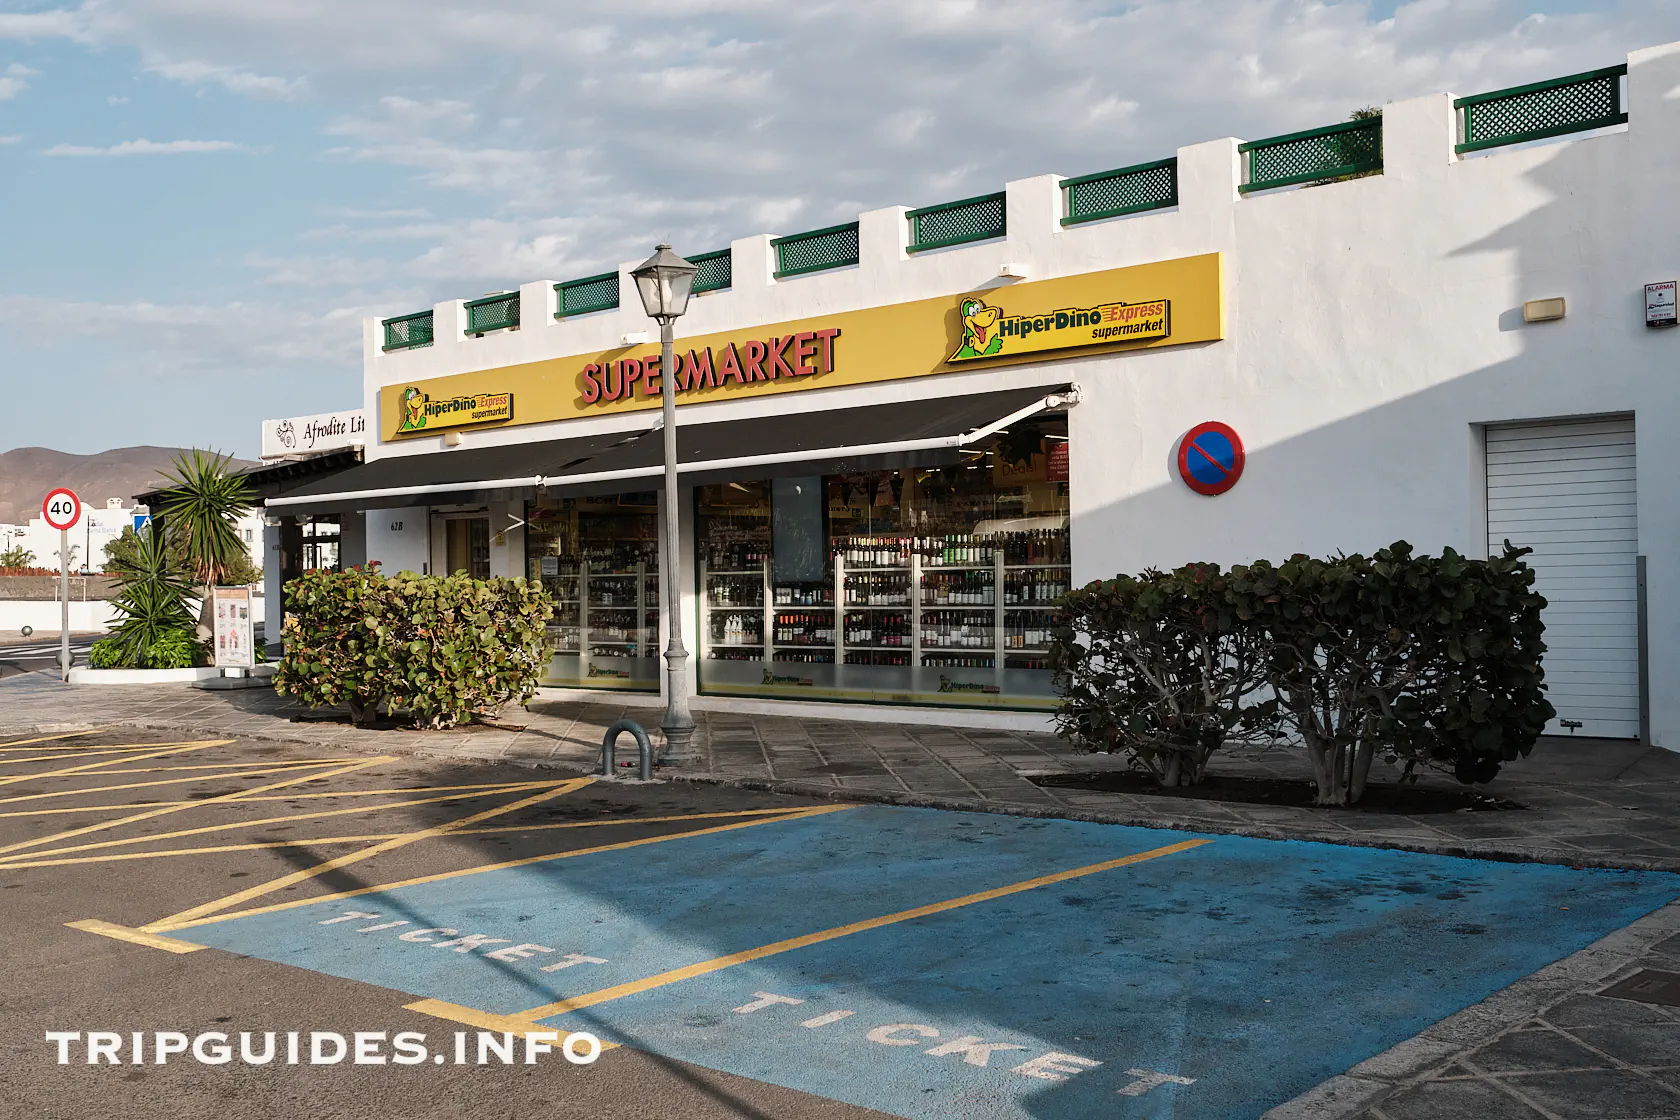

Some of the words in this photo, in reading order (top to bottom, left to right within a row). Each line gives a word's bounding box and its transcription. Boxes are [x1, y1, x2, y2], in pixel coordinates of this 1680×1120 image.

[999, 309, 1102, 339] HiperDino
[1109, 302, 1163, 323] Express
[1091, 318, 1164, 339] supermarket
[581, 327, 841, 404] SUPERMARKET
[424, 397, 477, 418] HiperDino
[480, 395, 507, 409] Express
[471, 406, 508, 420] supermarket
[303, 416, 346, 448] Afrodite
[50, 501, 72, 515] 40
[390, 521, 404, 531] 62B
[317, 910, 609, 974] TICKET
[731, 990, 1198, 1097] TICKET
